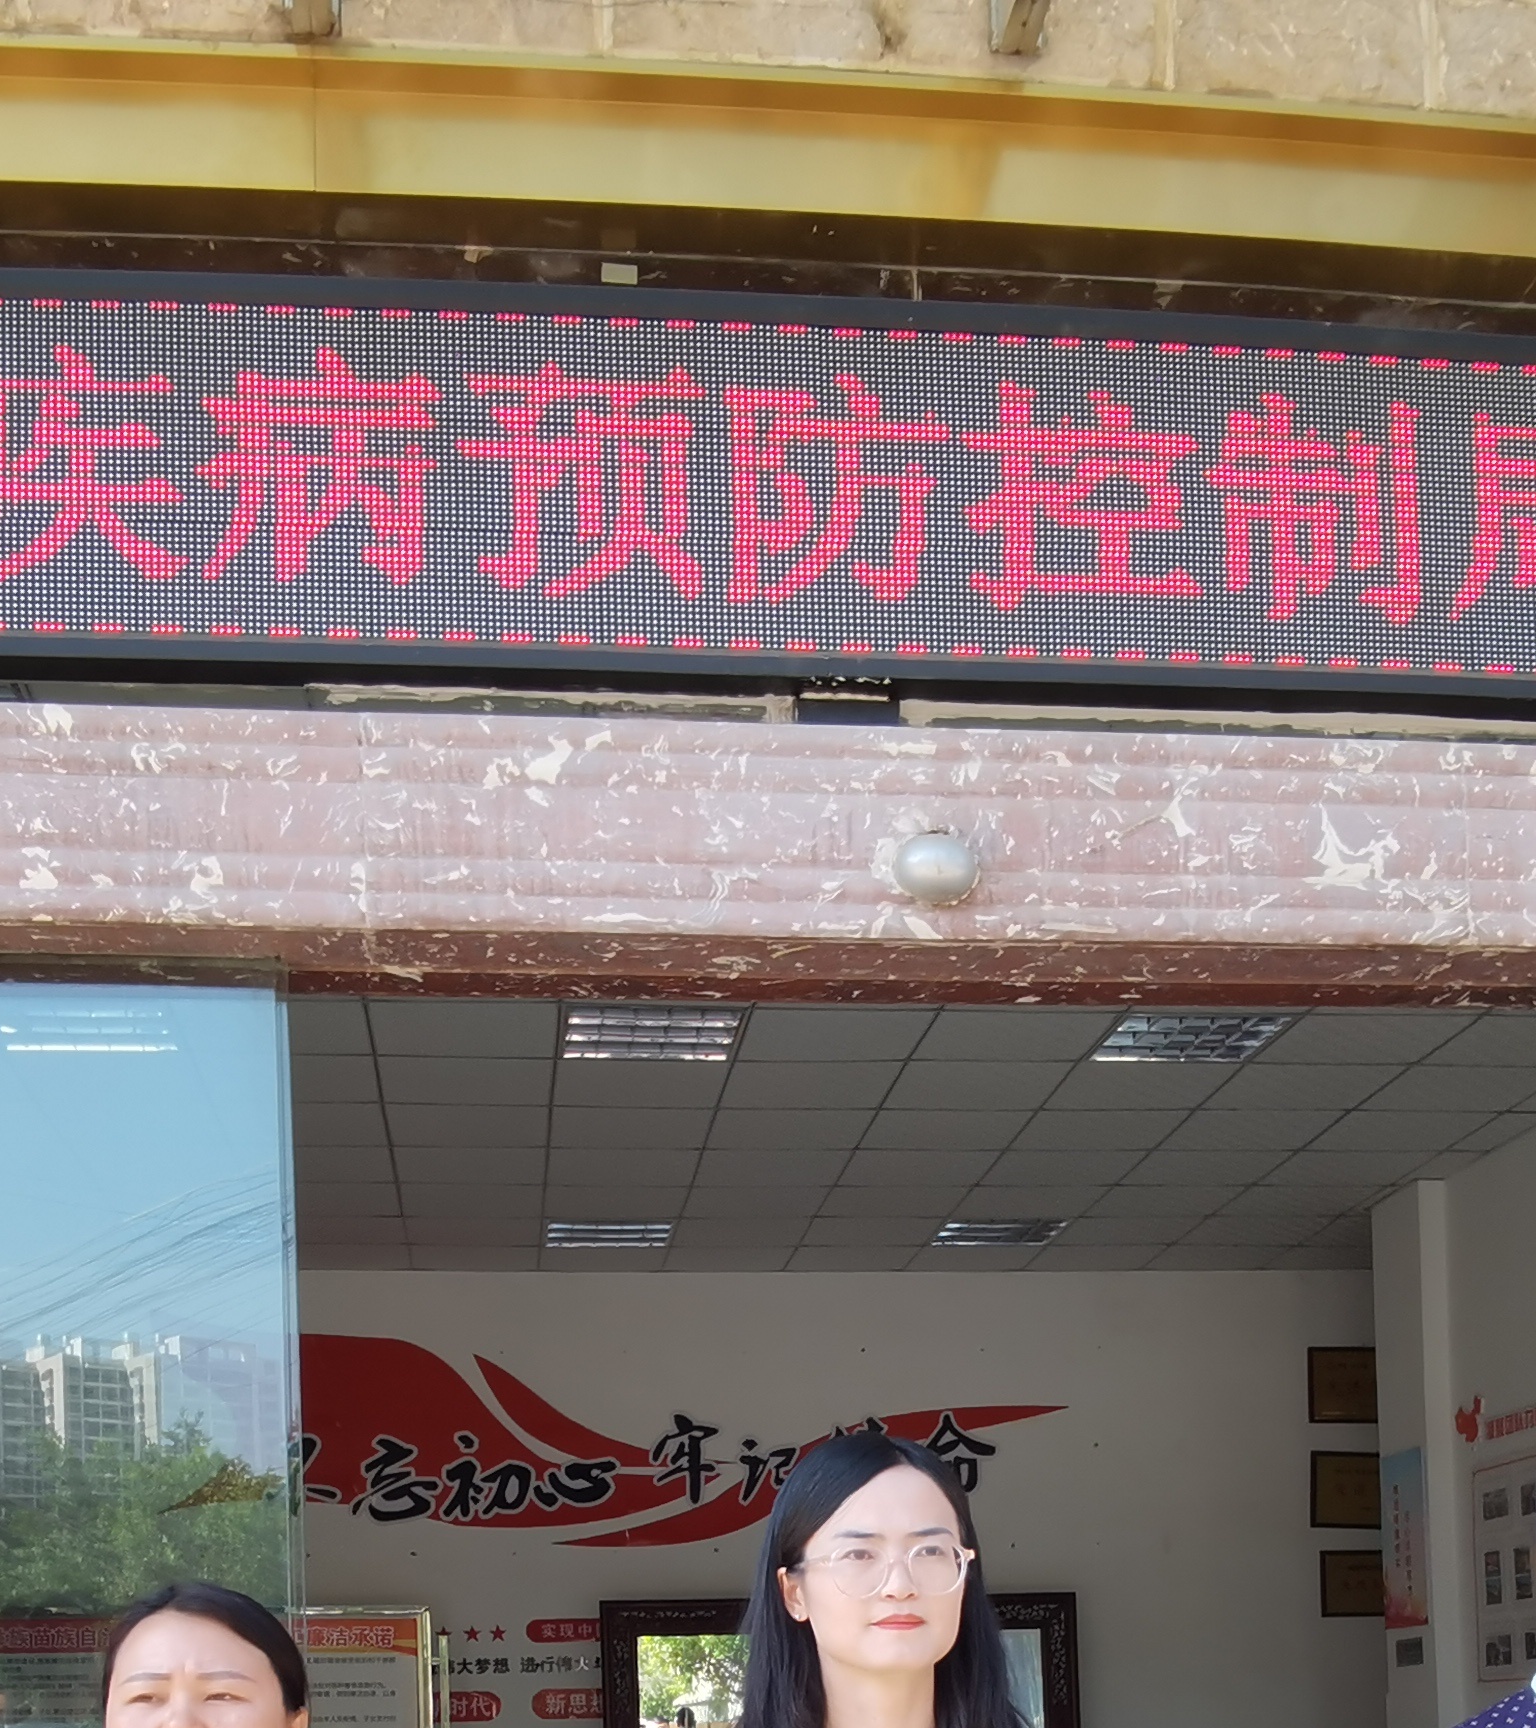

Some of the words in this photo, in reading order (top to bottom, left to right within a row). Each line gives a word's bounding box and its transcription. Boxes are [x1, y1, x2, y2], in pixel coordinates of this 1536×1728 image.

[651, 1413, 997, 1504] 牢记命
[541, 1622, 601, 1639] 实现中
